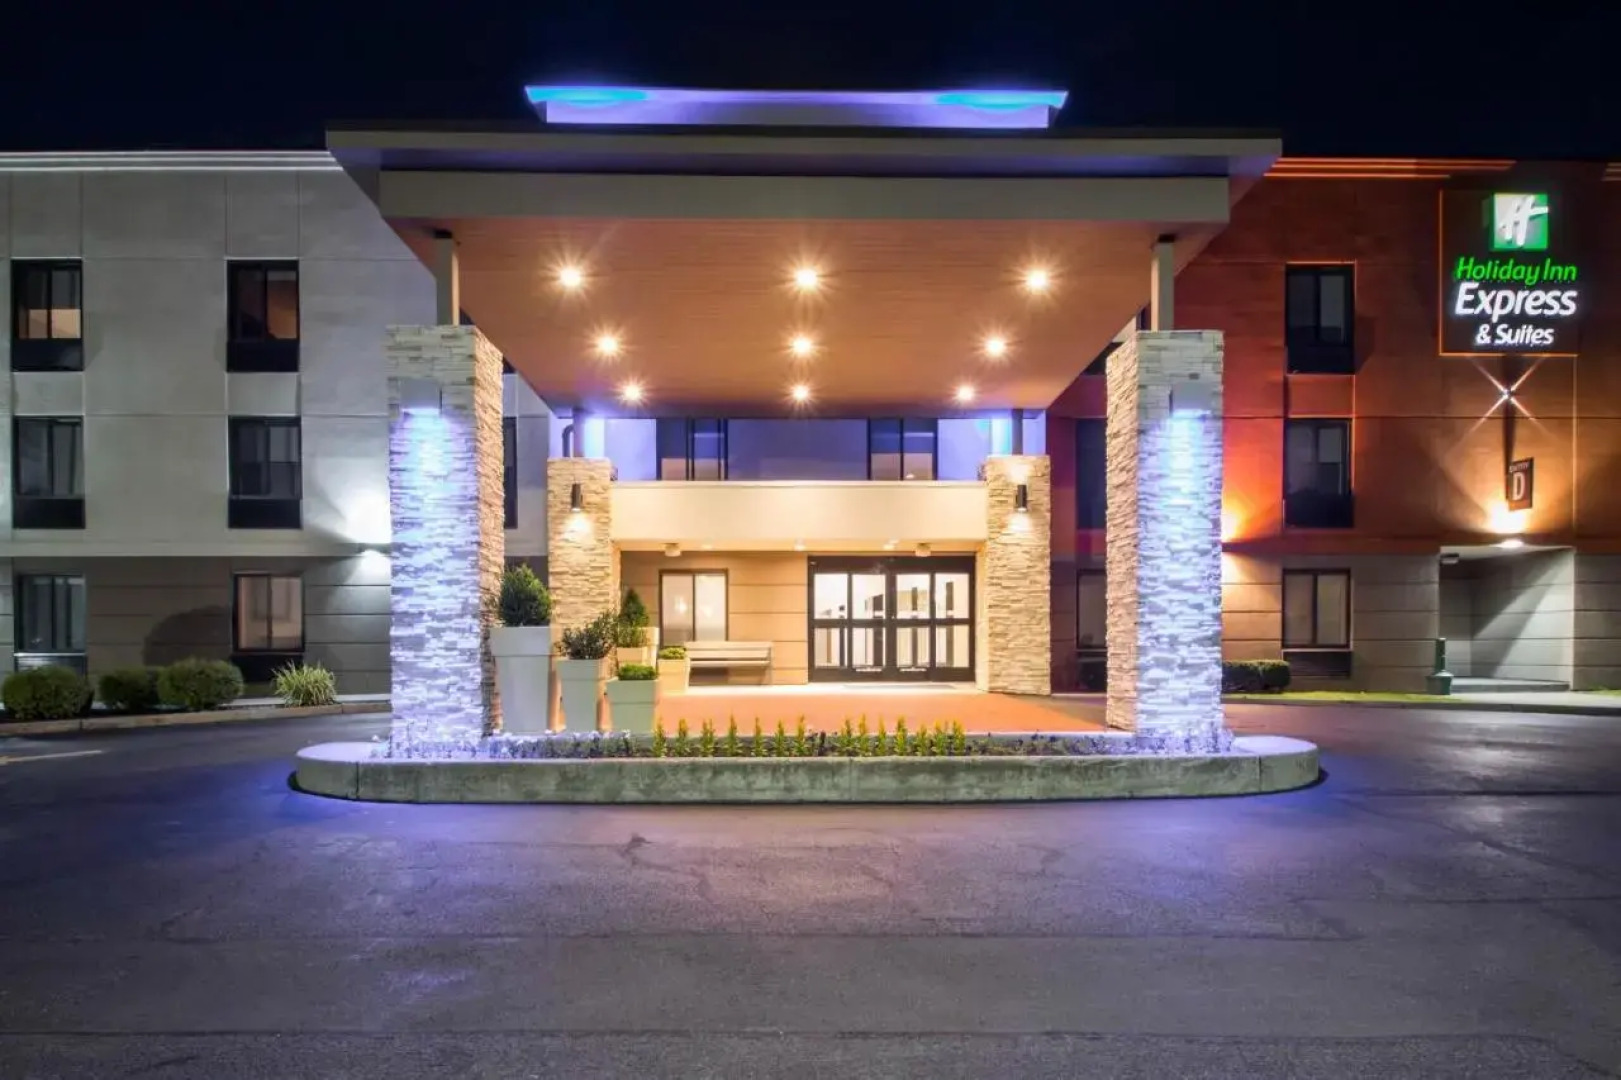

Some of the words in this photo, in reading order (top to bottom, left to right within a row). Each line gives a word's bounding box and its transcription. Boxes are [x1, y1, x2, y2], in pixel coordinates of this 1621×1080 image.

[1456, 257, 1540, 286] Holiday
[1543, 258, 1578, 281] Inn
[1454, 281, 1578, 323] Express
[1475, 324, 1491, 344] &
[1494, 323, 1555, 346] Suites
[1512, 471, 1526, 501] D
